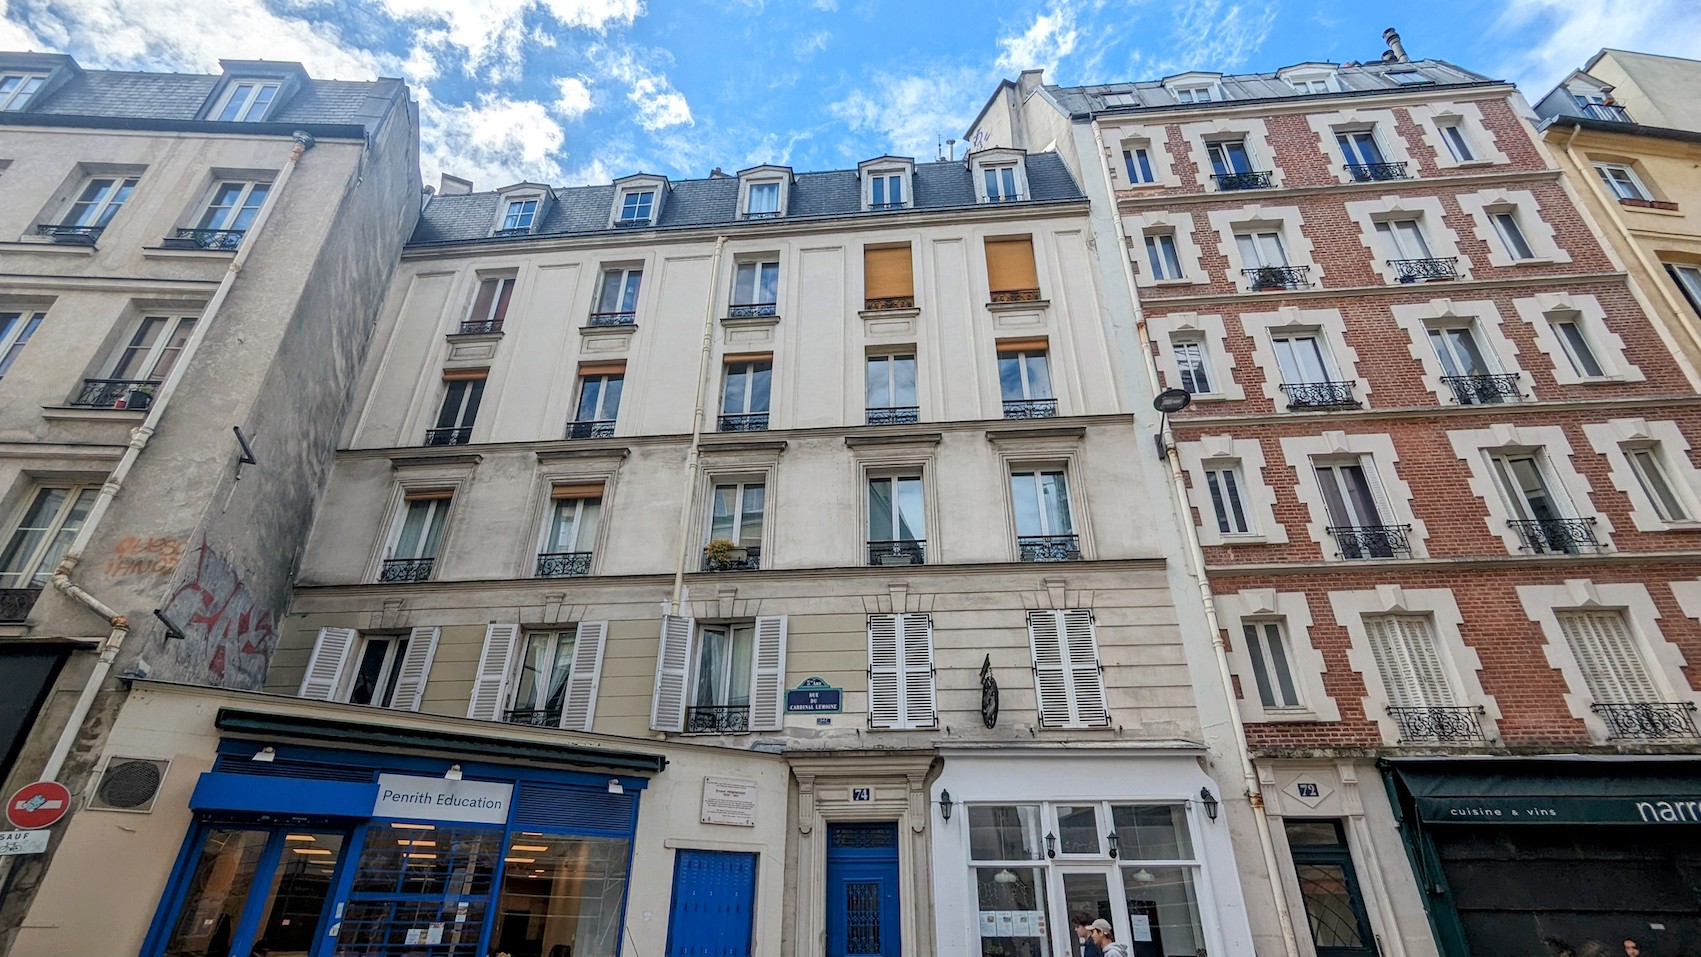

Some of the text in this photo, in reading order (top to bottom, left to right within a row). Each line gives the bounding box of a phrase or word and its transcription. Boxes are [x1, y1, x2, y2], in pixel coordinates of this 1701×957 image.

[854, 789, 868, 800] 74
[1299, 784, 1318, 796] 72
[382, 789, 502, 809] Penrith Education
[1450, 807, 1502, 816] cuisine
[1526, 807, 1557, 816] vins
[1636, 801, 1701, 822] narr
[0, 832, 30, 841] SAUF
